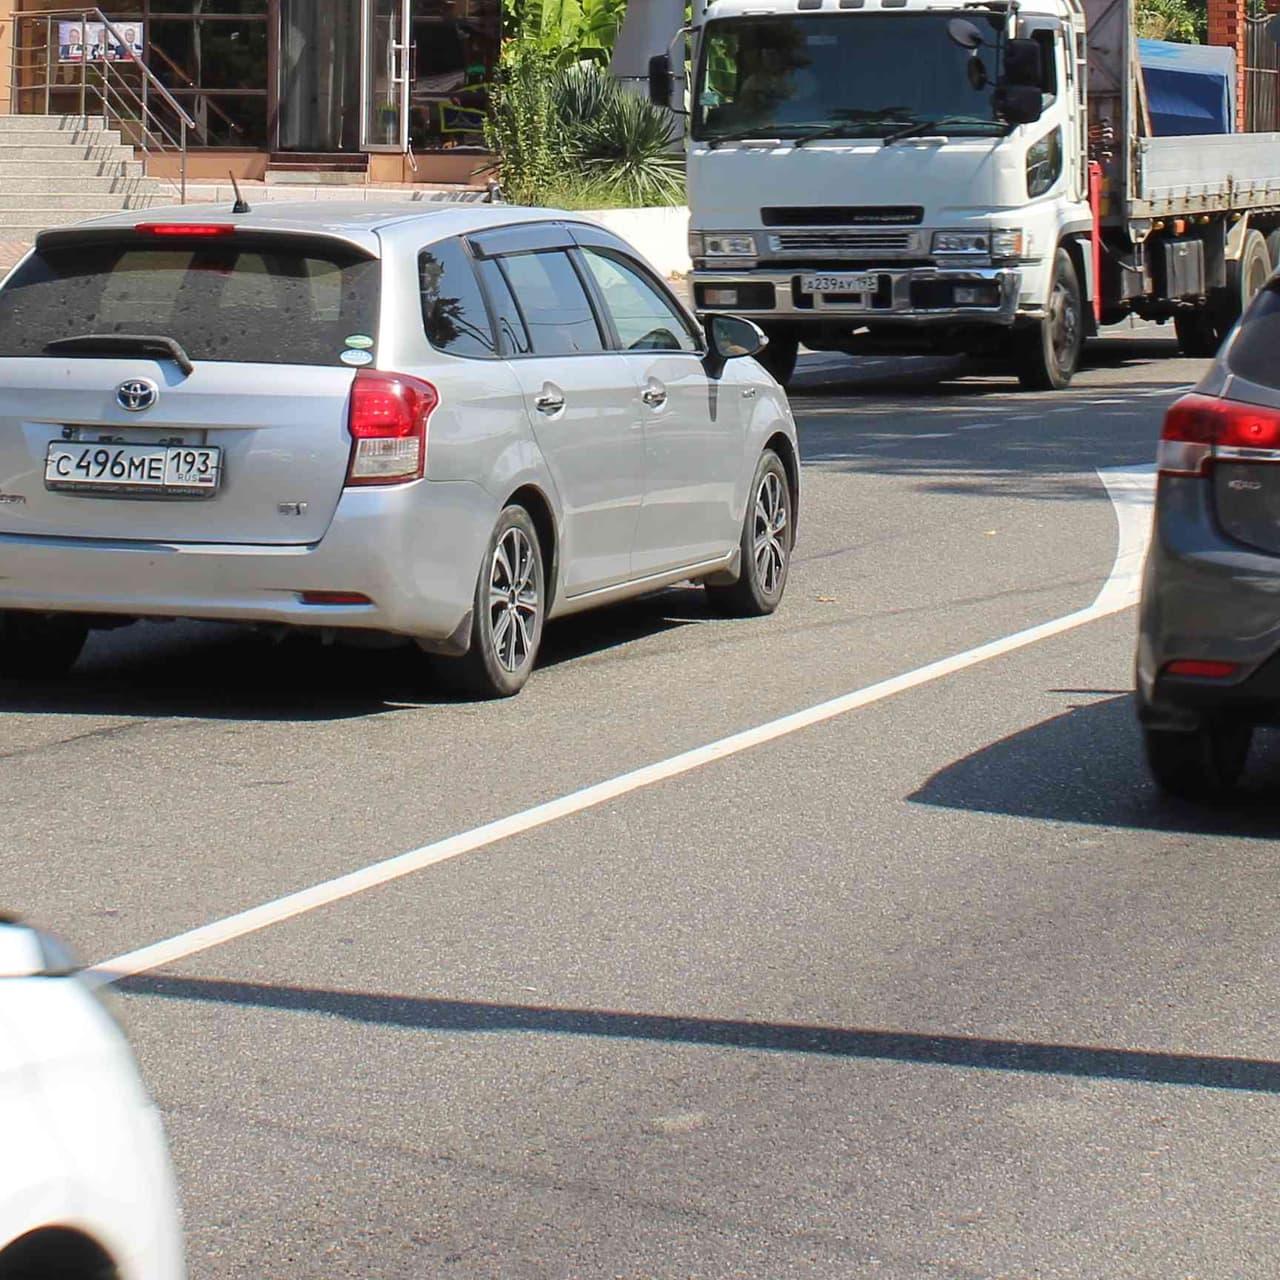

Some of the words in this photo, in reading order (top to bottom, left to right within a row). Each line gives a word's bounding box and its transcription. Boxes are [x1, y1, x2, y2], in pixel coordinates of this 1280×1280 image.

[56, 449, 163, 480] С496МЕ
[171, 451, 210, 474] 193
[177, 474, 197, 482] RUS
